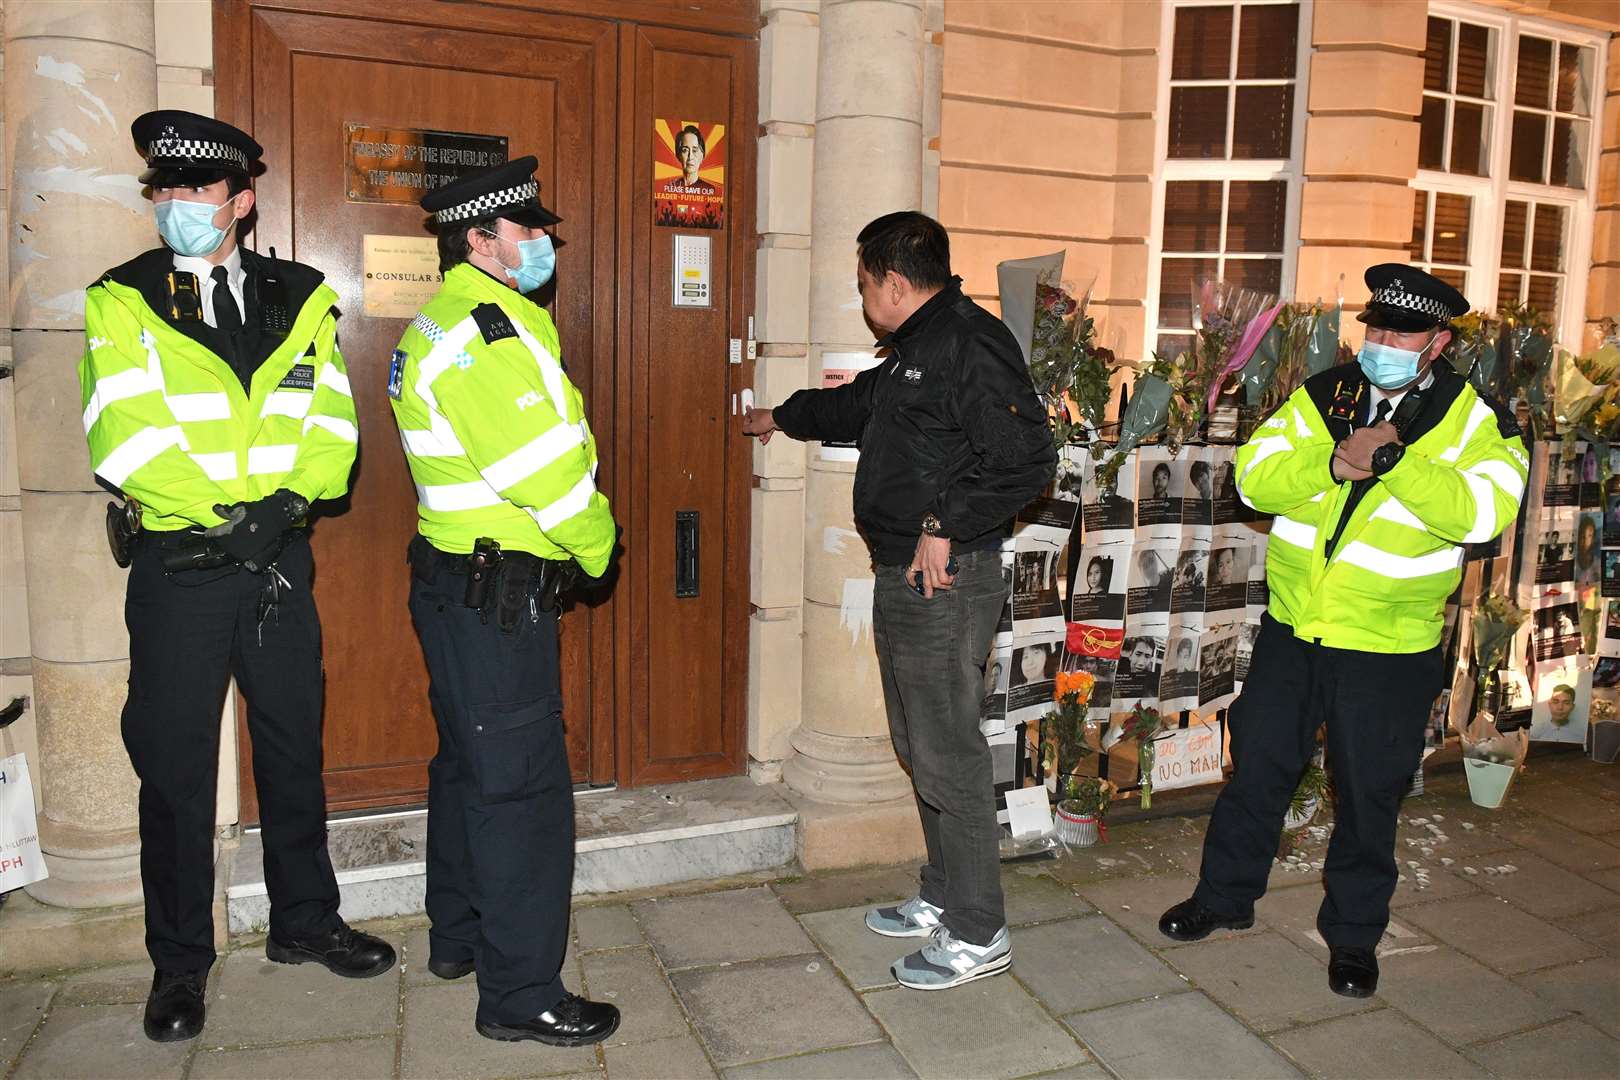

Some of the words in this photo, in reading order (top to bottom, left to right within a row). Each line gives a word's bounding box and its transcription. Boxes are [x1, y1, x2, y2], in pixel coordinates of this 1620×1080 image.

[403, 144, 417, 161] OF
[418, 146, 438, 163] THE
[440, 148, 488, 167] REPUBLIC
[368, 169, 389, 186] THE
[391, 171, 422, 188] UNION
[425, 173, 438, 190] OF
[655, 192, 678, 200] LEADER
[681, 194, 705, 202] FUTURE
[707, 196, 724, 204] HOPE
[664, 185, 684, 193] PLEASE
[702, 187, 715, 196] OUR
[375, 272, 432, 283] CONSULAR
[1159, 761, 1182, 781] NO
[1190, 753, 1219, 775] MAH
